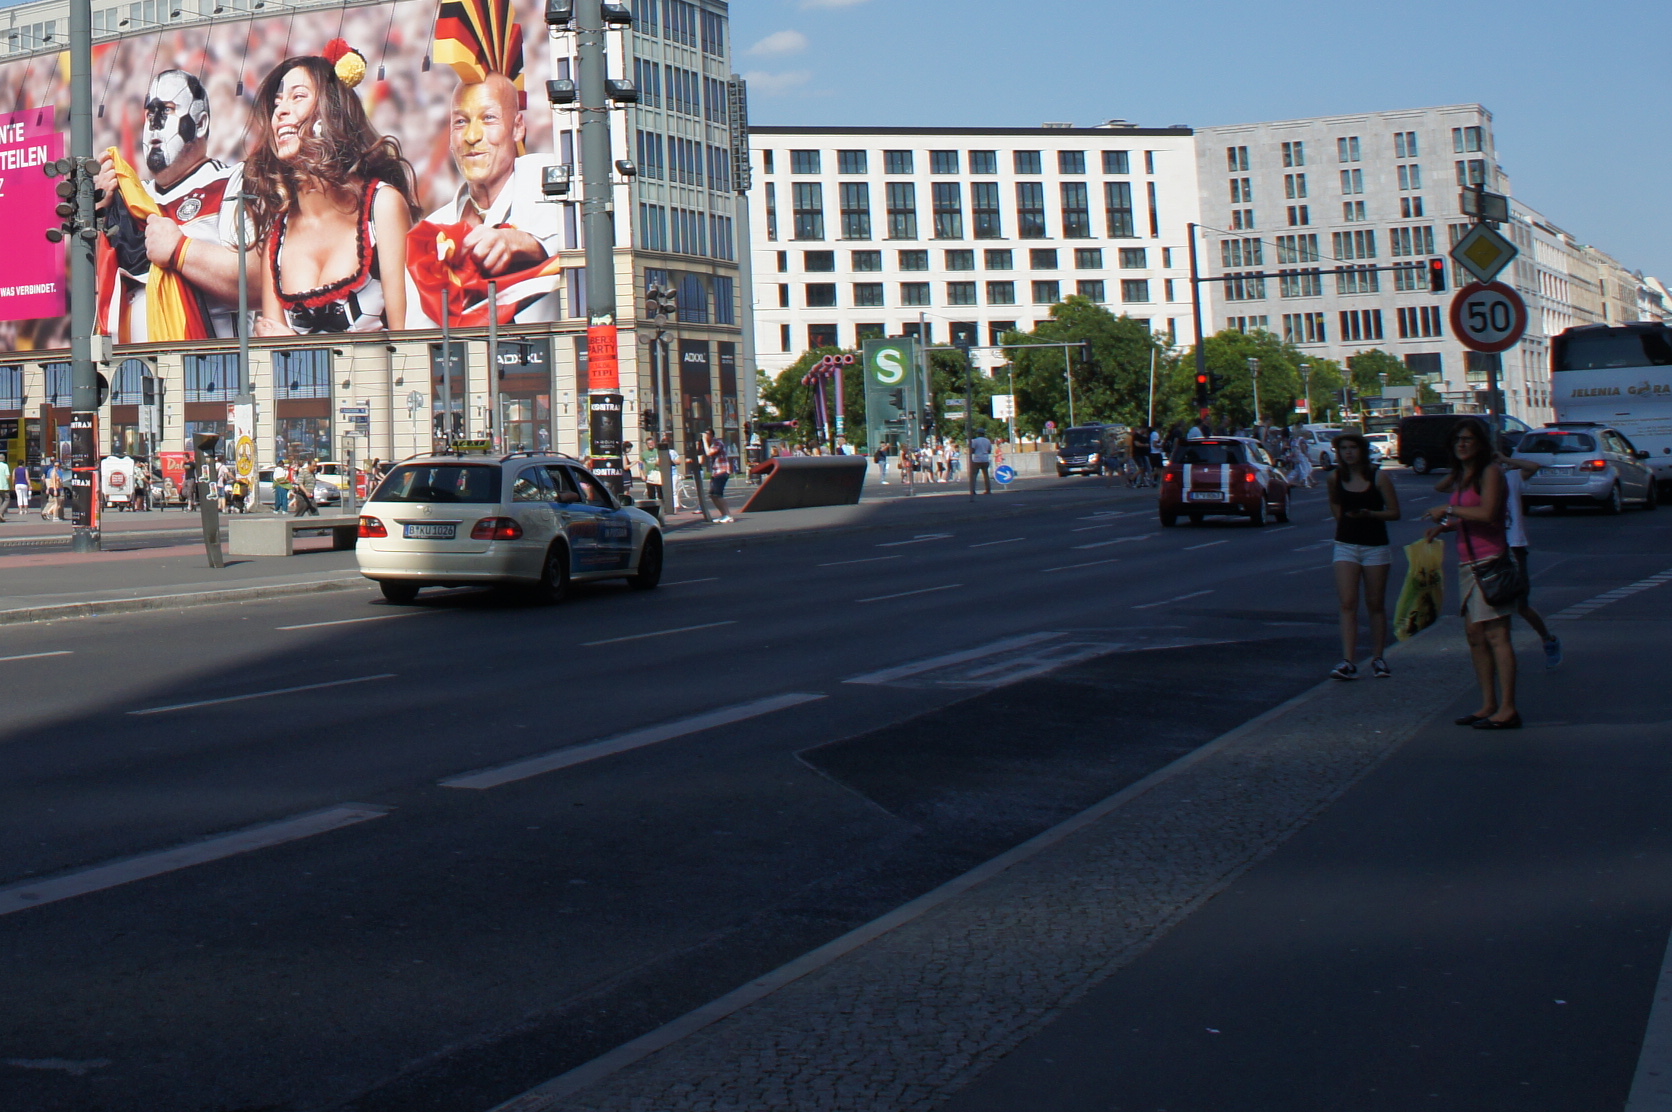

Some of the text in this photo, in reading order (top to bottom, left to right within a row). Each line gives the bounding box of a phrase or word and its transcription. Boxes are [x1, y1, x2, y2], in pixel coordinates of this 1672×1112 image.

[0, 145, 48, 171] TEILEN
[1, 286, 15, 297] WAS
[16, 283, 57, 295] VERBINDET.
[1468, 300, 1510, 334] 50
[876, 349, 903, 383] S
[1571, 387, 1620, 398] JELENIA
